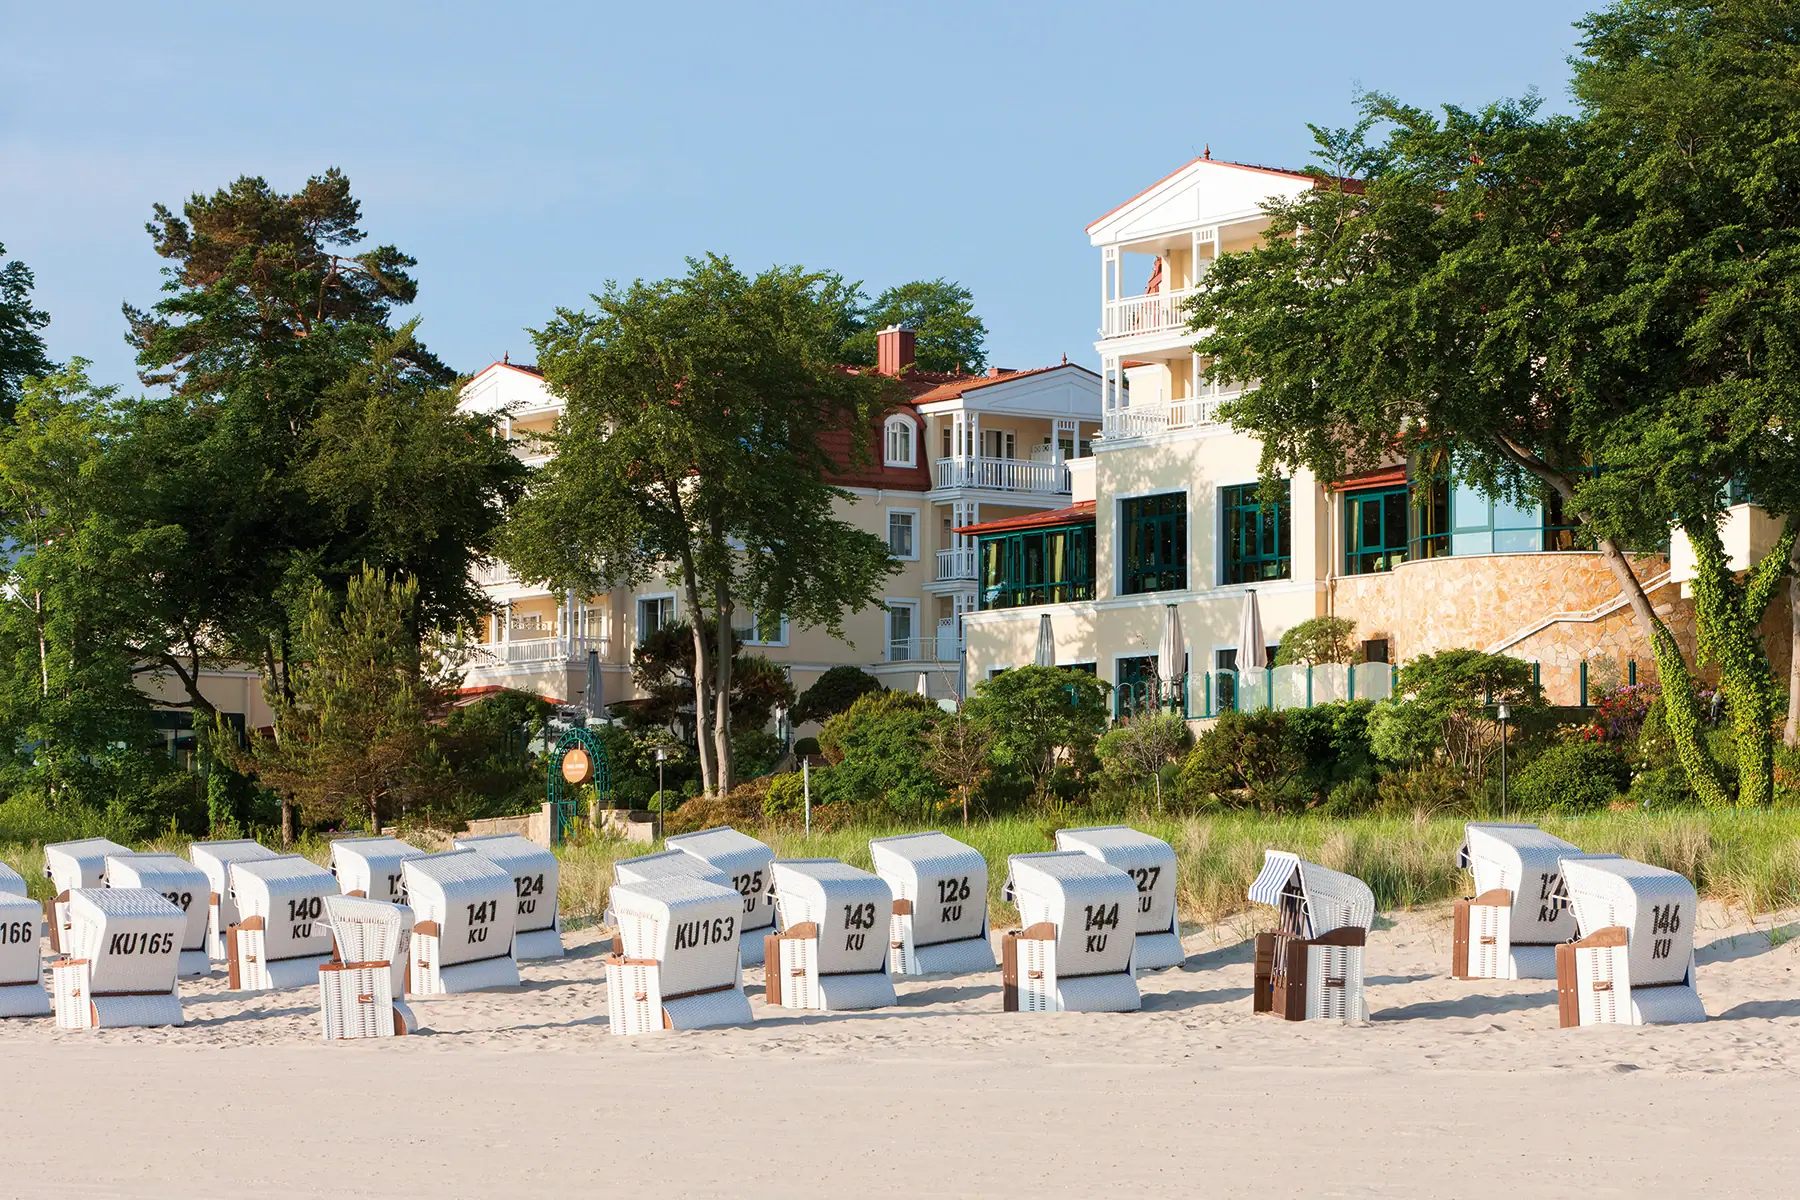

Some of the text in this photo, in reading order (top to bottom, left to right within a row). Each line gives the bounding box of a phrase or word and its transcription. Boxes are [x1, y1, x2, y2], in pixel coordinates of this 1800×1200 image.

[514, 874, 543, 897] 124
[733, 871, 762, 896] 125
[938, 877, 970, 903] 126
[288, 897, 321, 921] 140
[467, 900, 496, 925] 141
[518, 900, 536, 914] KU
[844, 903, 875, 929] 143
[942, 905, 962, 922] KU
[1085, 903, 1119, 931] 144
[1538, 904, 1559, 922] KU
[1653, 904, 1679, 934] 146
[292, 924, 311, 939] KU
[468, 927, 487, 944] KU
[675, 917, 733, 950] KU163
[846, 934, 865, 951] KU
[109, 933, 173, 954] KU165
[1086, 934, 1107, 952] KU
[1653, 939, 1671, 959] KU
